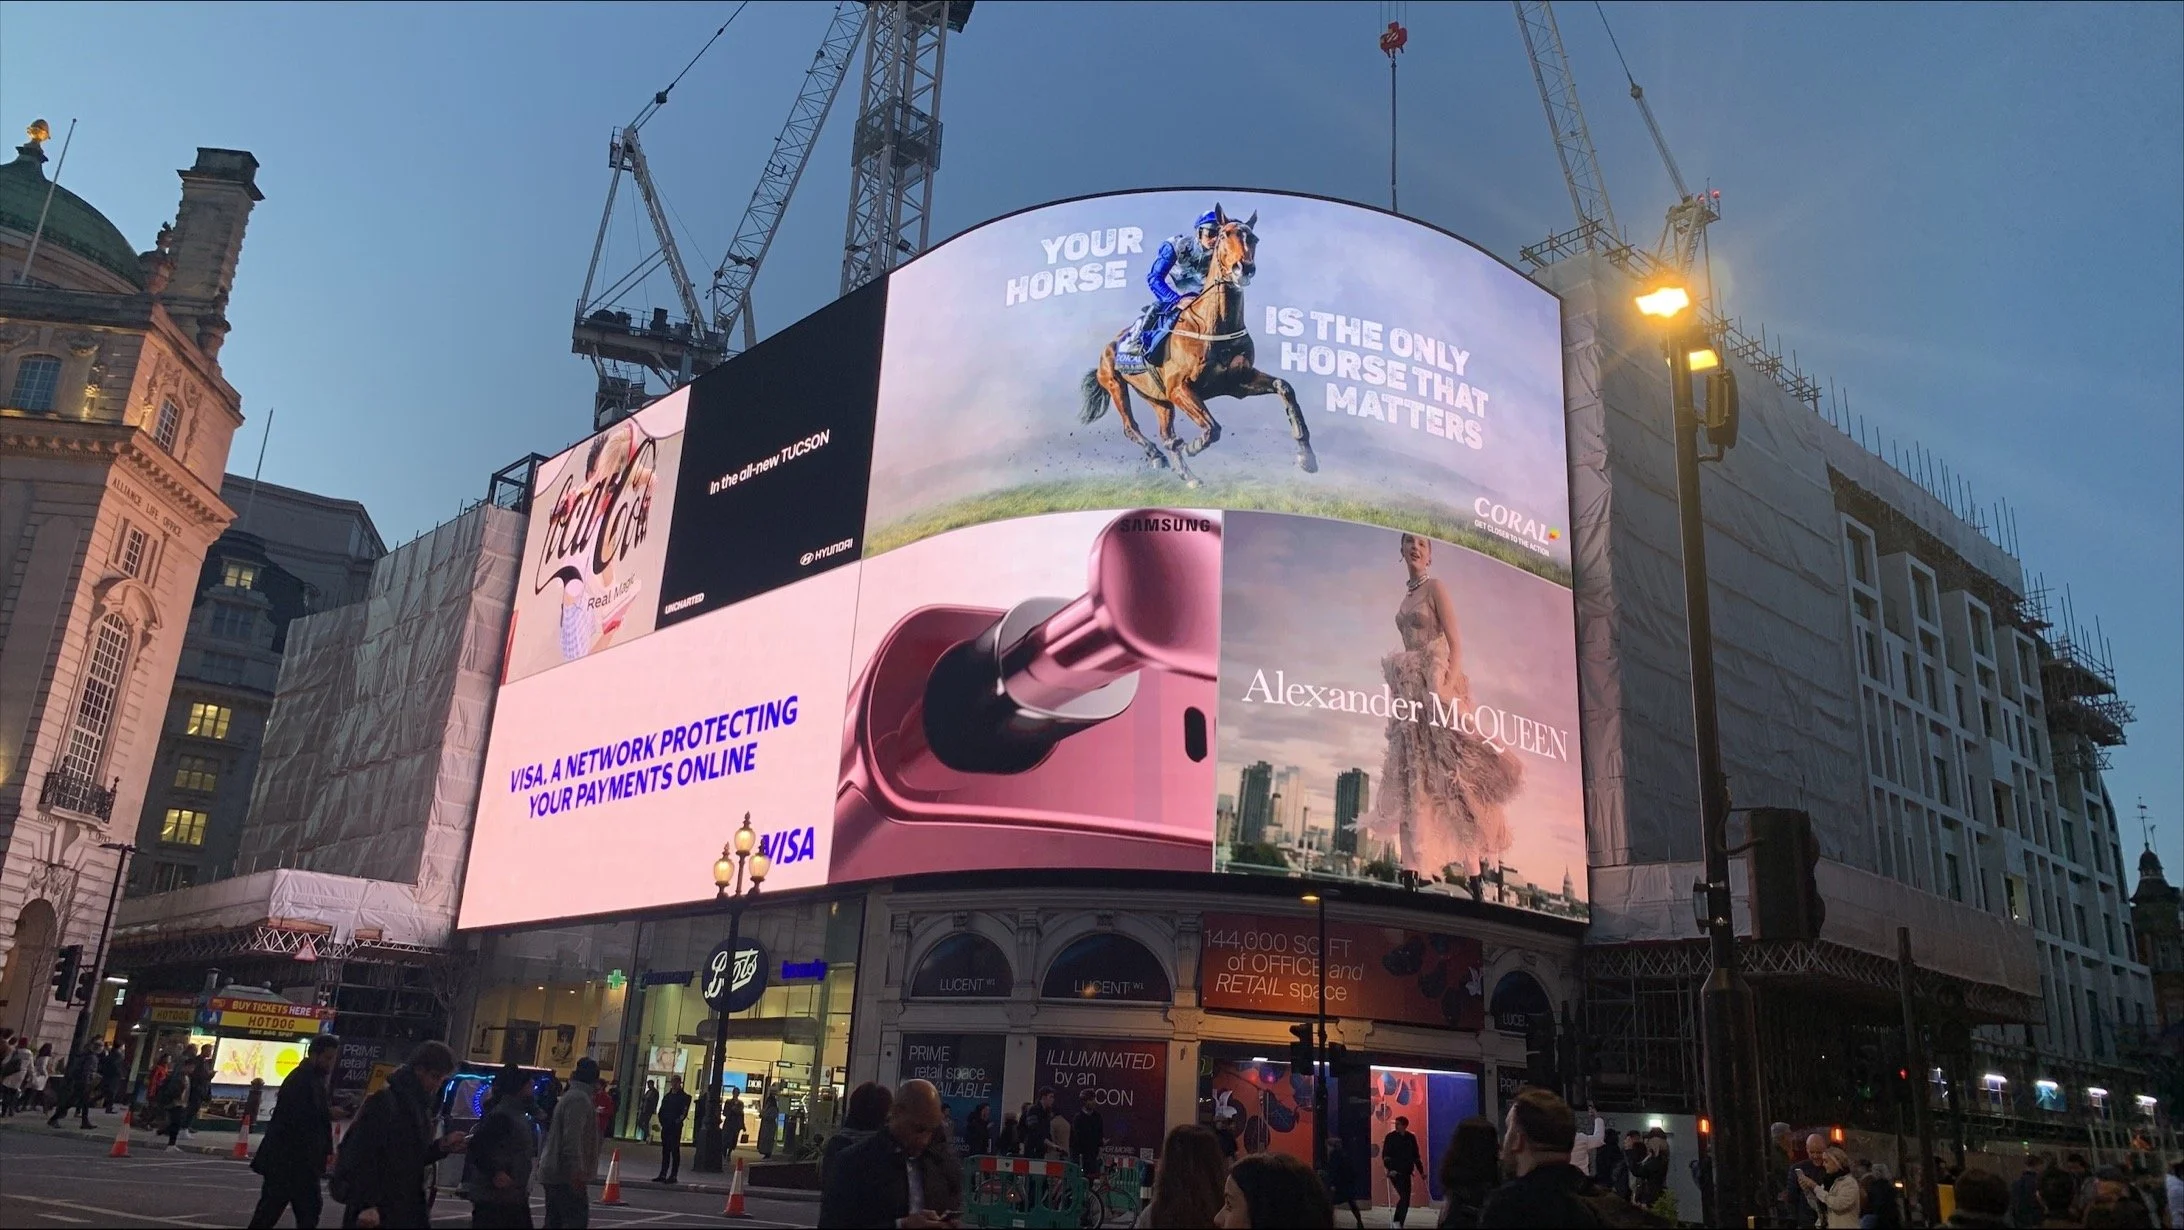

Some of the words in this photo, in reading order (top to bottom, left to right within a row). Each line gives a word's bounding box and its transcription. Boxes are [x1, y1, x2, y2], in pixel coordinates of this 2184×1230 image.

[1041, 226, 1143, 264] YOUR
[1006, 260, 1127, 307] HORSE
[1265, 306, 1304, 337] IS
[1310, 310, 1383, 351] THE
[1389, 328, 1470, 376] ONLY
[1281, 342, 1407, 391] HORSE
[1412, 366, 1488, 419] THAT
[1326, 382, 1483, 451] MATTERS
[709, 481, 720, 495] In
[721, 473, 738, 490] the
[739, 453, 780, 482] all-new
[780, 429, 830, 463] TUCSON
[112, 477, 142, 507] ALLIANCE
[145, 503, 159, 520] LIFE
[163, 516, 182, 537] OFFICE
[1474, 497, 1549, 545] CORAL
[1119, 518, 1210, 533] SAMSUNG
[1474, 519, 1486, 530] GET
[1487, 524, 1510, 540] CLOSER
[1510, 533, 1518, 543] TO
[1518, 537, 1529, 548] THE
[1529, 543, 1550, 557] ACTION
[814, 538, 853, 561] HYUNDAI
[587, 593, 612, 611] Real
[613, 573, 636, 600] Magic
[664, 593, 705, 615] UNCHARTED
[1242, 668, 1423, 723] Alexander
[1429, 692, 1568, 762] McQUEEN
[511, 763, 547, 793] VISA.
[550, 758, 561, 784] A
[565, 733, 658, 780] NETWORK
[660, 695, 798, 756] PROTECTING
[529, 787, 572, 819] YOUR
[575, 762, 673, 809] PAYMENTS
[677, 742, 758, 786] ONLINE
[1204, 928, 1287, 952] 144,000
[1329, 938, 1352, 957] FT
[704, 948, 759, 999] Bots
[1227, 953, 1247, 972] of
[1251, 953, 1320, 977] OFFICE
[1328, 963, 1364, 981] and
[939, 978, 984, 992] LUCENT
[1074, 979, 1128, 995] LUCENT
[1215, 973, 1284, 997] RETAIL
[1289, 980, 1347, 1001] space
[232, 1000, 249, 1010] BUY
[252, 1002, 288, 1014] TICKETS
[288, 1004, 312, 1017] HERE
[248, 1016, 295, 1029] HOTDOG
[340, 1058, 368, 1069] retail
[343, 1044, 381, 1058] PRIME
[908, 1045, 951, 1061] PRIME
[1046, 1050, 1156, 1070] ILLUMINATED
[914, 1065, 942, 1079] retail
[945, 1067, 985, 1081] space
[1054, 1068, 1071, 1087] by
[1076, 1071, 1096, 1086] an
[936, 1082, 992, 1099] AILABLE
[1093, 1088, 1133, 1106] CON
